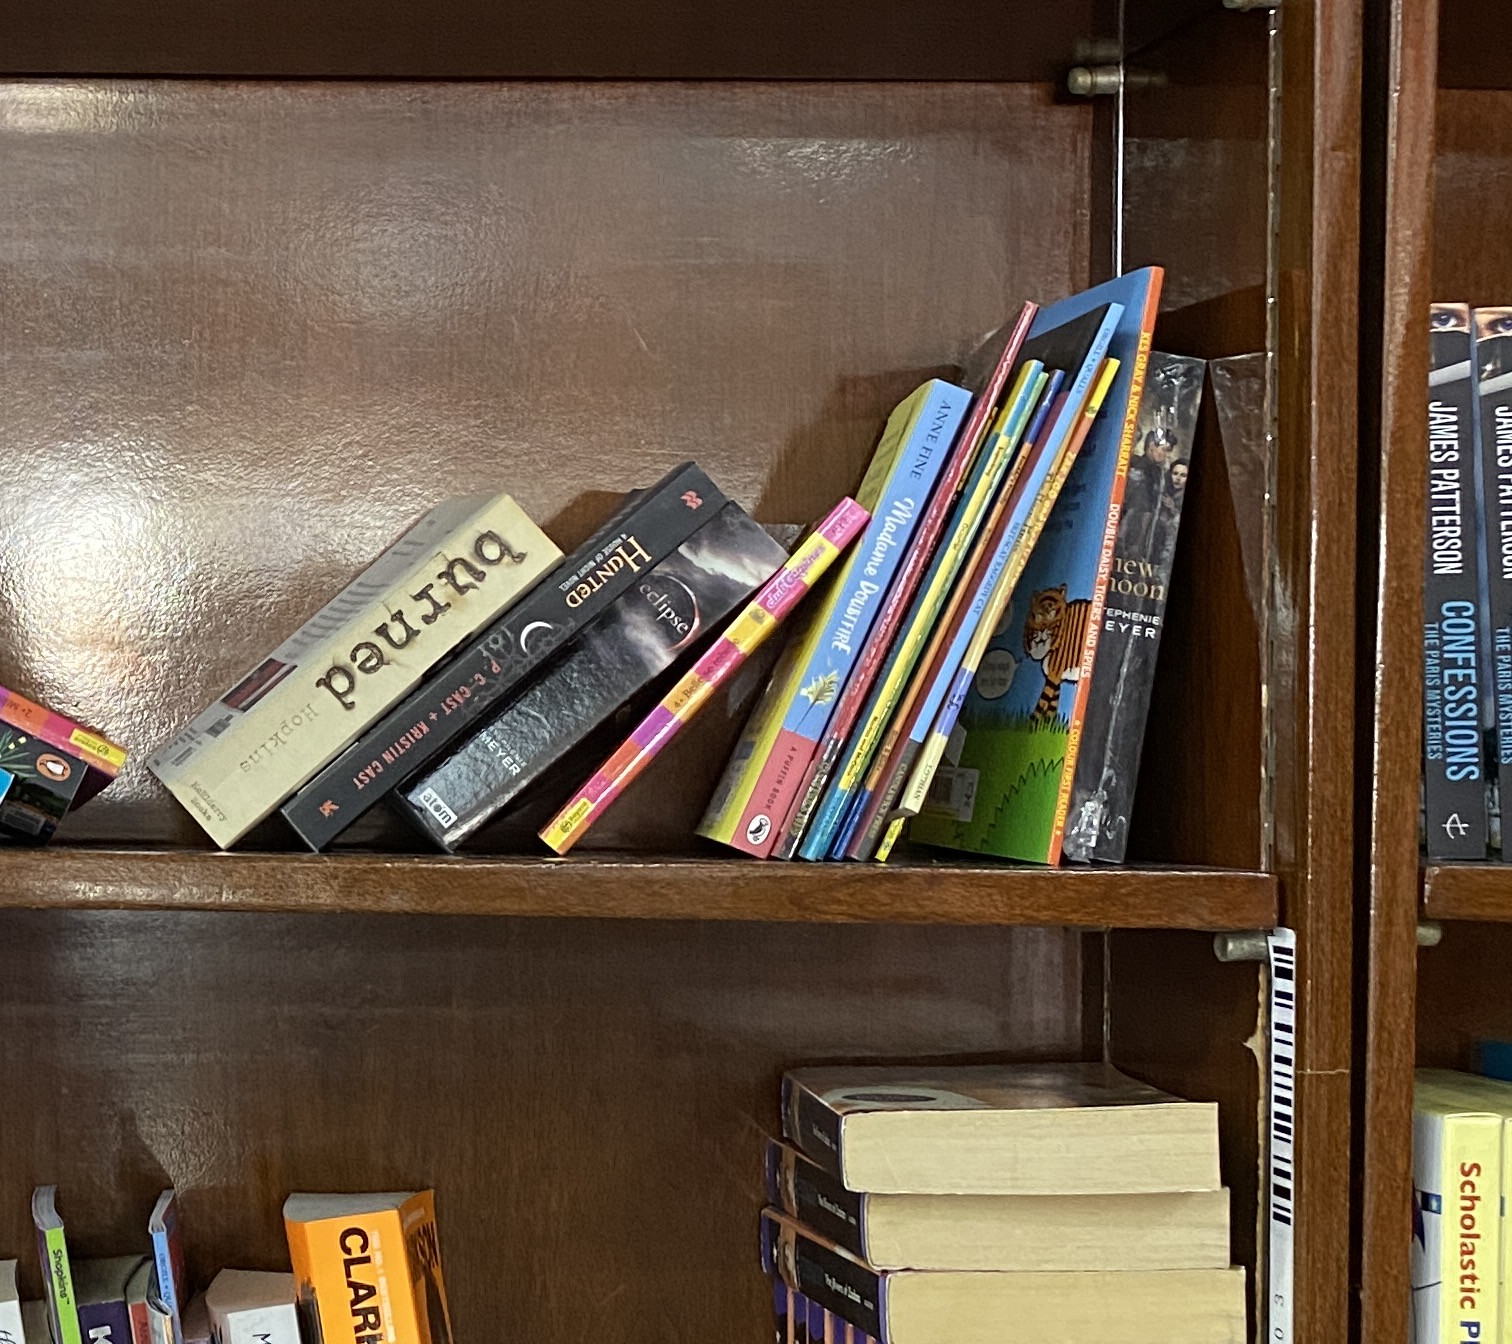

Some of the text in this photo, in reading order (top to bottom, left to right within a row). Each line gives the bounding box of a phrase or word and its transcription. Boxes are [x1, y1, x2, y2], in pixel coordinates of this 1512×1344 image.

[909, 400, 952, 479] ANNE FINE
[1429, 401, 1463, 575] JAMES PATTERSON
[639, 584, 689, 635] eclipse
[864, 496, 915, 578] Madame
[316, 531, 527, 710] burned
[1441, 601, 1479, 782] CONFESSIONS
[1458, 1161, 1483, 1310] Scholastic
